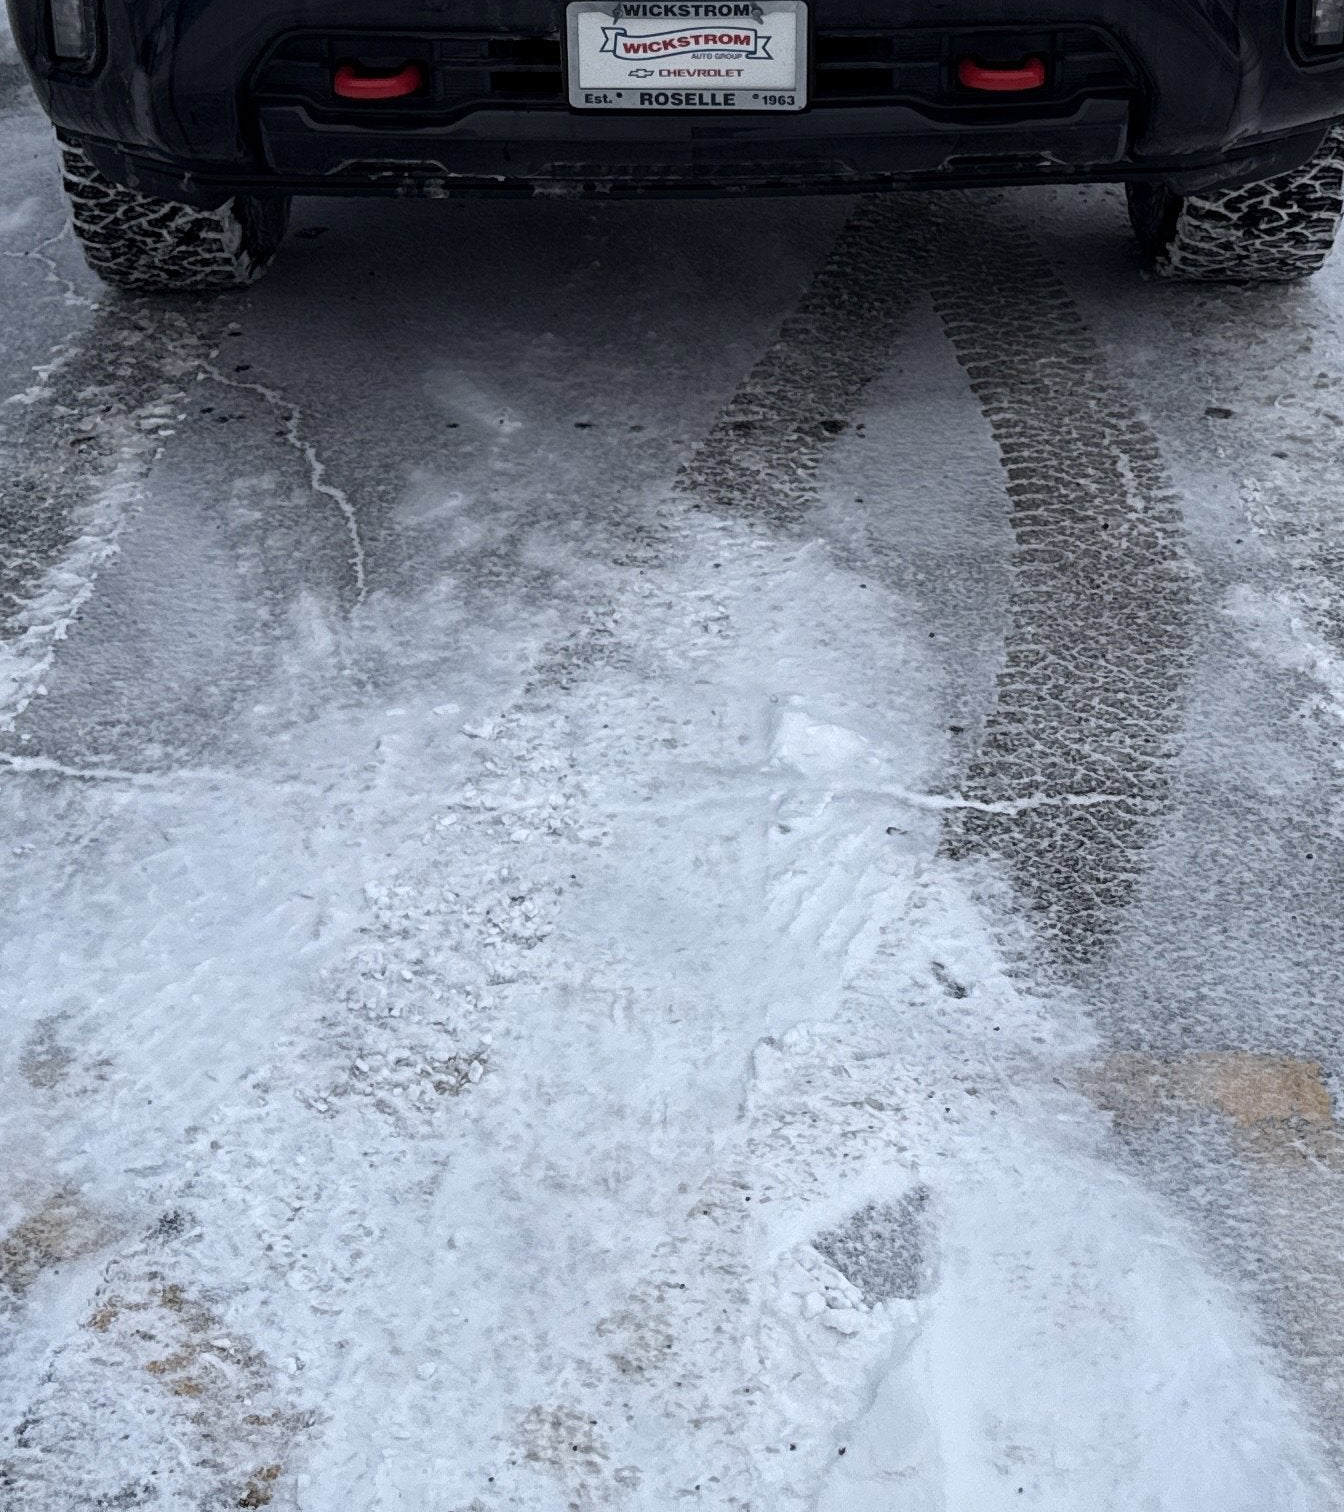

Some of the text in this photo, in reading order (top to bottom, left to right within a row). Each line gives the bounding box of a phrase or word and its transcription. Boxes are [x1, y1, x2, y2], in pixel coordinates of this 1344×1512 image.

[622, 3, 751, 18] WICKSTROM
[622, 33, 752, 55] WICKSTROM
[690, 52, 743, 60] AUTO GROUP
[658, 68, 744, 78] CHEVROLET
[584, 92, 795, 107] Est. ROSELLE 1963
